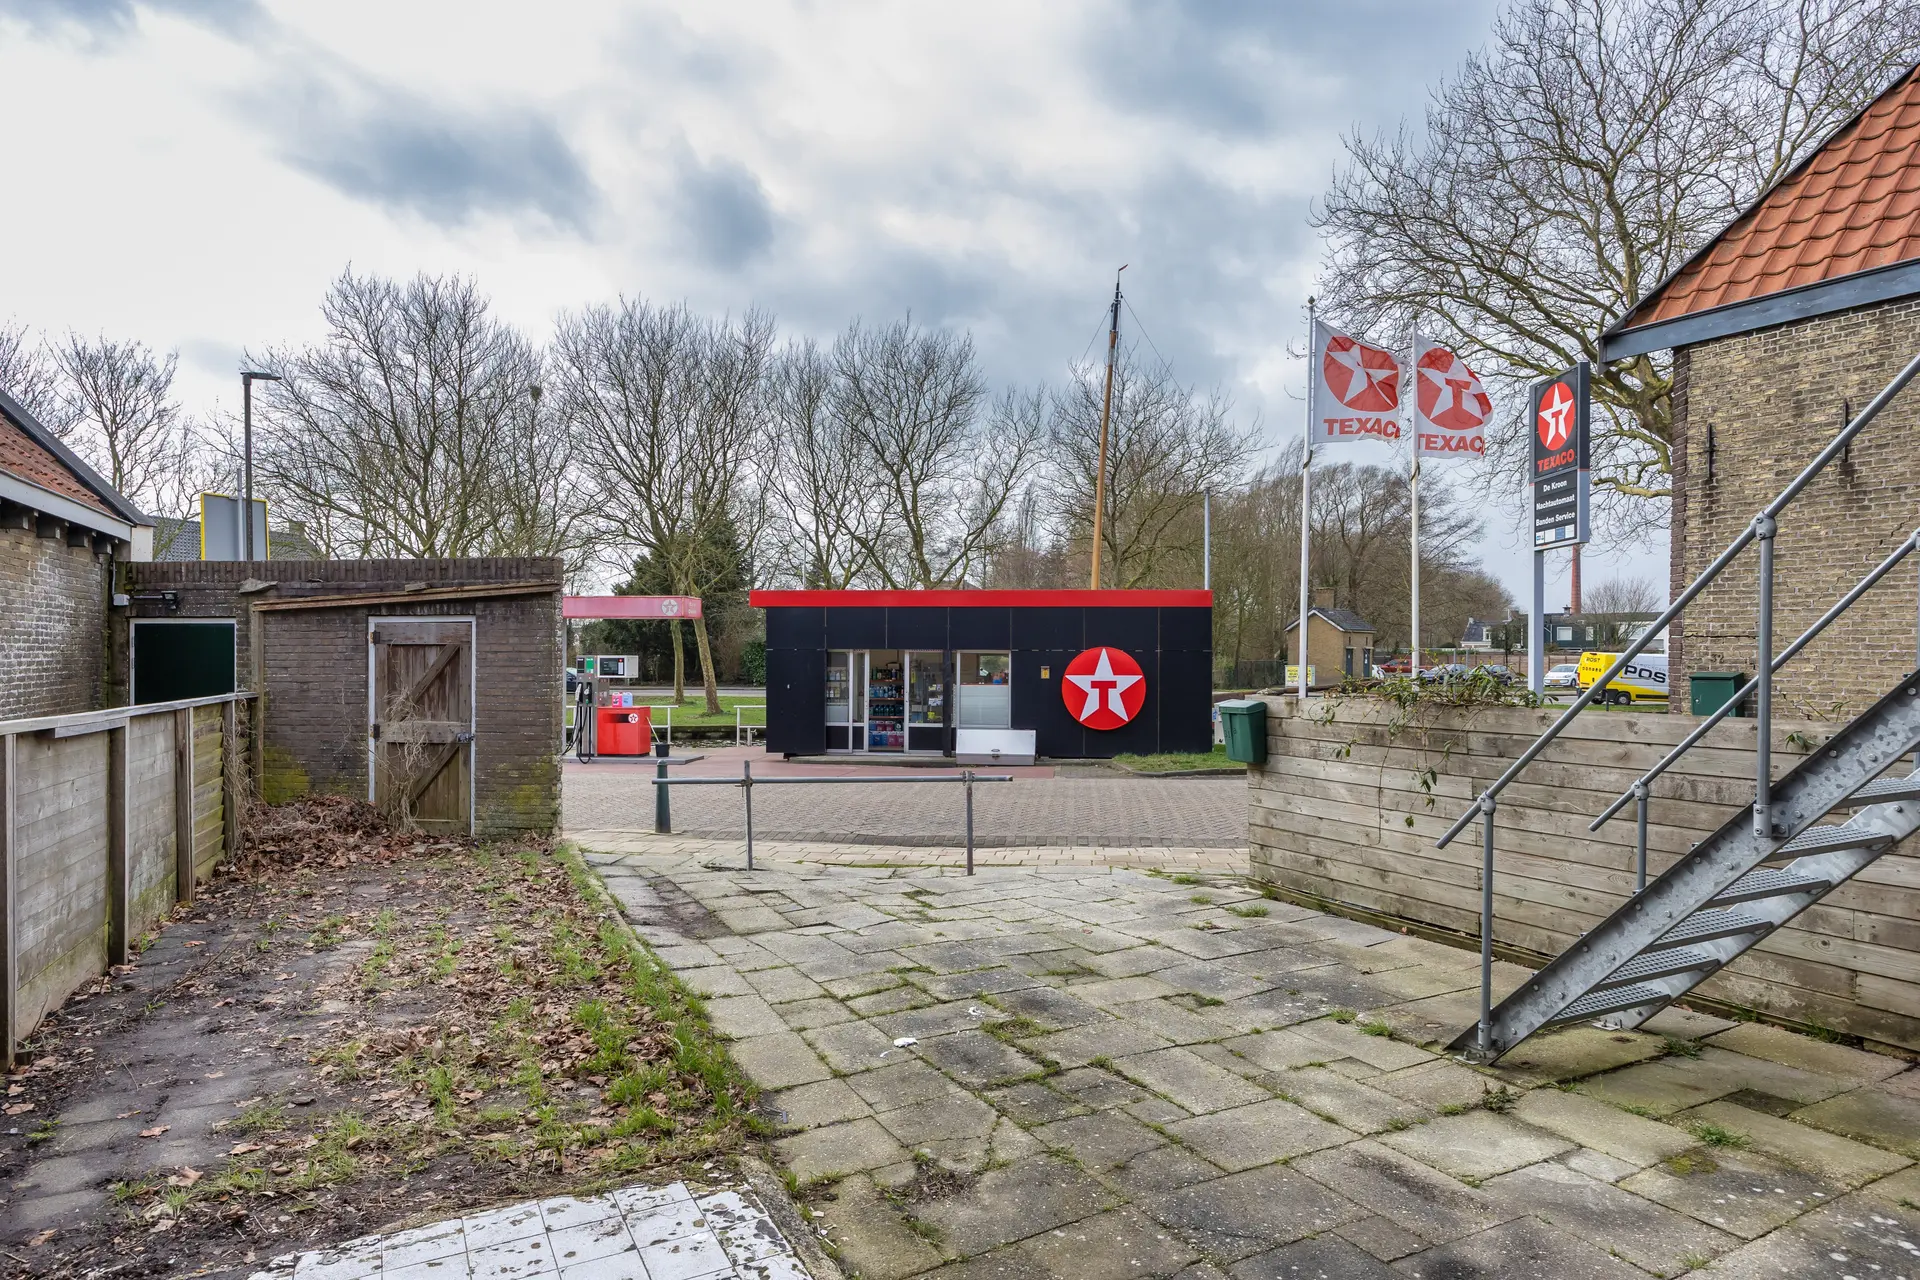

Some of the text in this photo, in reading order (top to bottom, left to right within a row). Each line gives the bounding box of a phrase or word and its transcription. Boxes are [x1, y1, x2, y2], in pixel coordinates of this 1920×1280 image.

[1418, 433, 1485, 456] TEXAC
[1537, 449, 1575, 472] TEXACO
[1543, 480, 1567, 493] De Kroon
[1536, 494, 1575, 510] Nachtautomaat
[1536, 511, 1576, 527] Banden Service
[1624, 664, 1667, 684] POS
